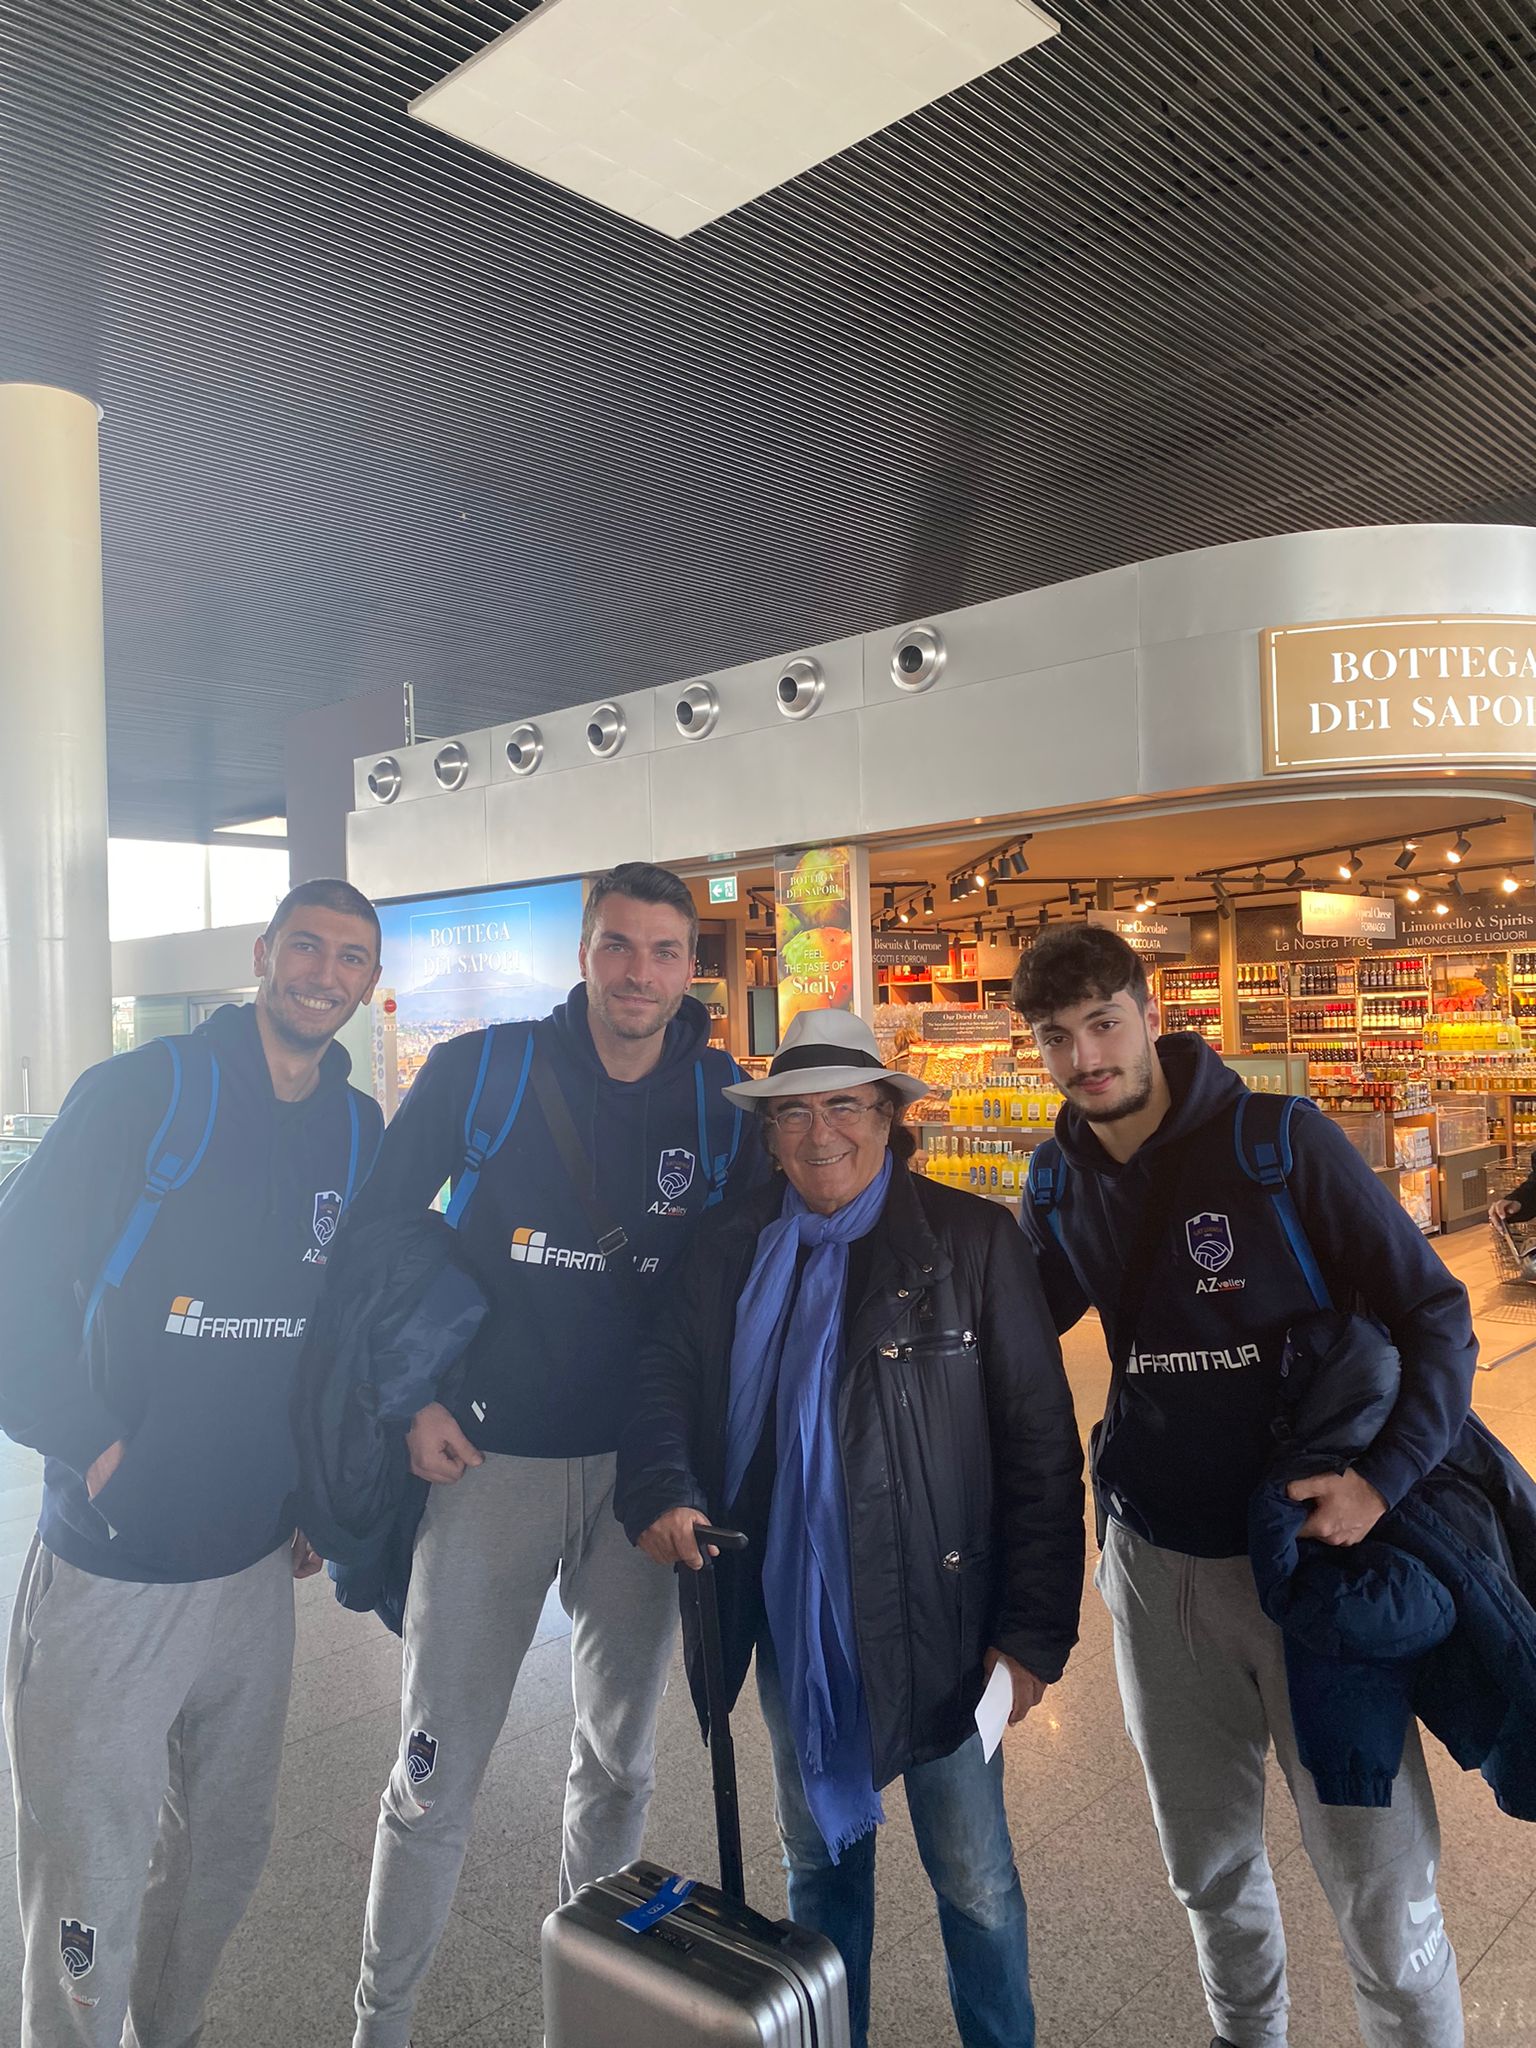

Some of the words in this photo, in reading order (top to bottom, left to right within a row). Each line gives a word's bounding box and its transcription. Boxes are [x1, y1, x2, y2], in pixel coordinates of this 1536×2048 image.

[1331, 646, 1536, 684] BOTTEGA
[1309, 698, 1392, 734] DEI
[790, 872, 834, 886] BOTTEGA
[805, 884, 839, 897] SAPORI
[1116, 919, 1133, 933] Fine
[1133, 920, 1169, 935] Chocolate
[1401, 917, 1472, 934] Limoncello
[1475, 915, 1486, 929] &
[1489, 912, 1535, 931] Spirits
[430, 920, 511, 948] BOTTEGA
[1406, 933, 1473, 947] LIMONCELLO
[1475, 933, 1482, 942] E
[1484, 930, 1528, 943] LIQUORI
[874, 938, 903, 950] Biscuits
[903, 939, 911, 950] &
[912, 939, 942, 951] Torrone
[1275, 939, 1290, 952] La
[1294, 938, 1339, 950] Nostra
[804, 949, 824, 959] FEEL
[423, 956, 452, 977] DEI
[457, 950, 520, 974] SAPORI
[784, 963, 802, 974] THE
[803, 961, 830, 973] TASTE
[831, 960, 846, 971] OF
[792, 974, 839, 1000] Sicily
